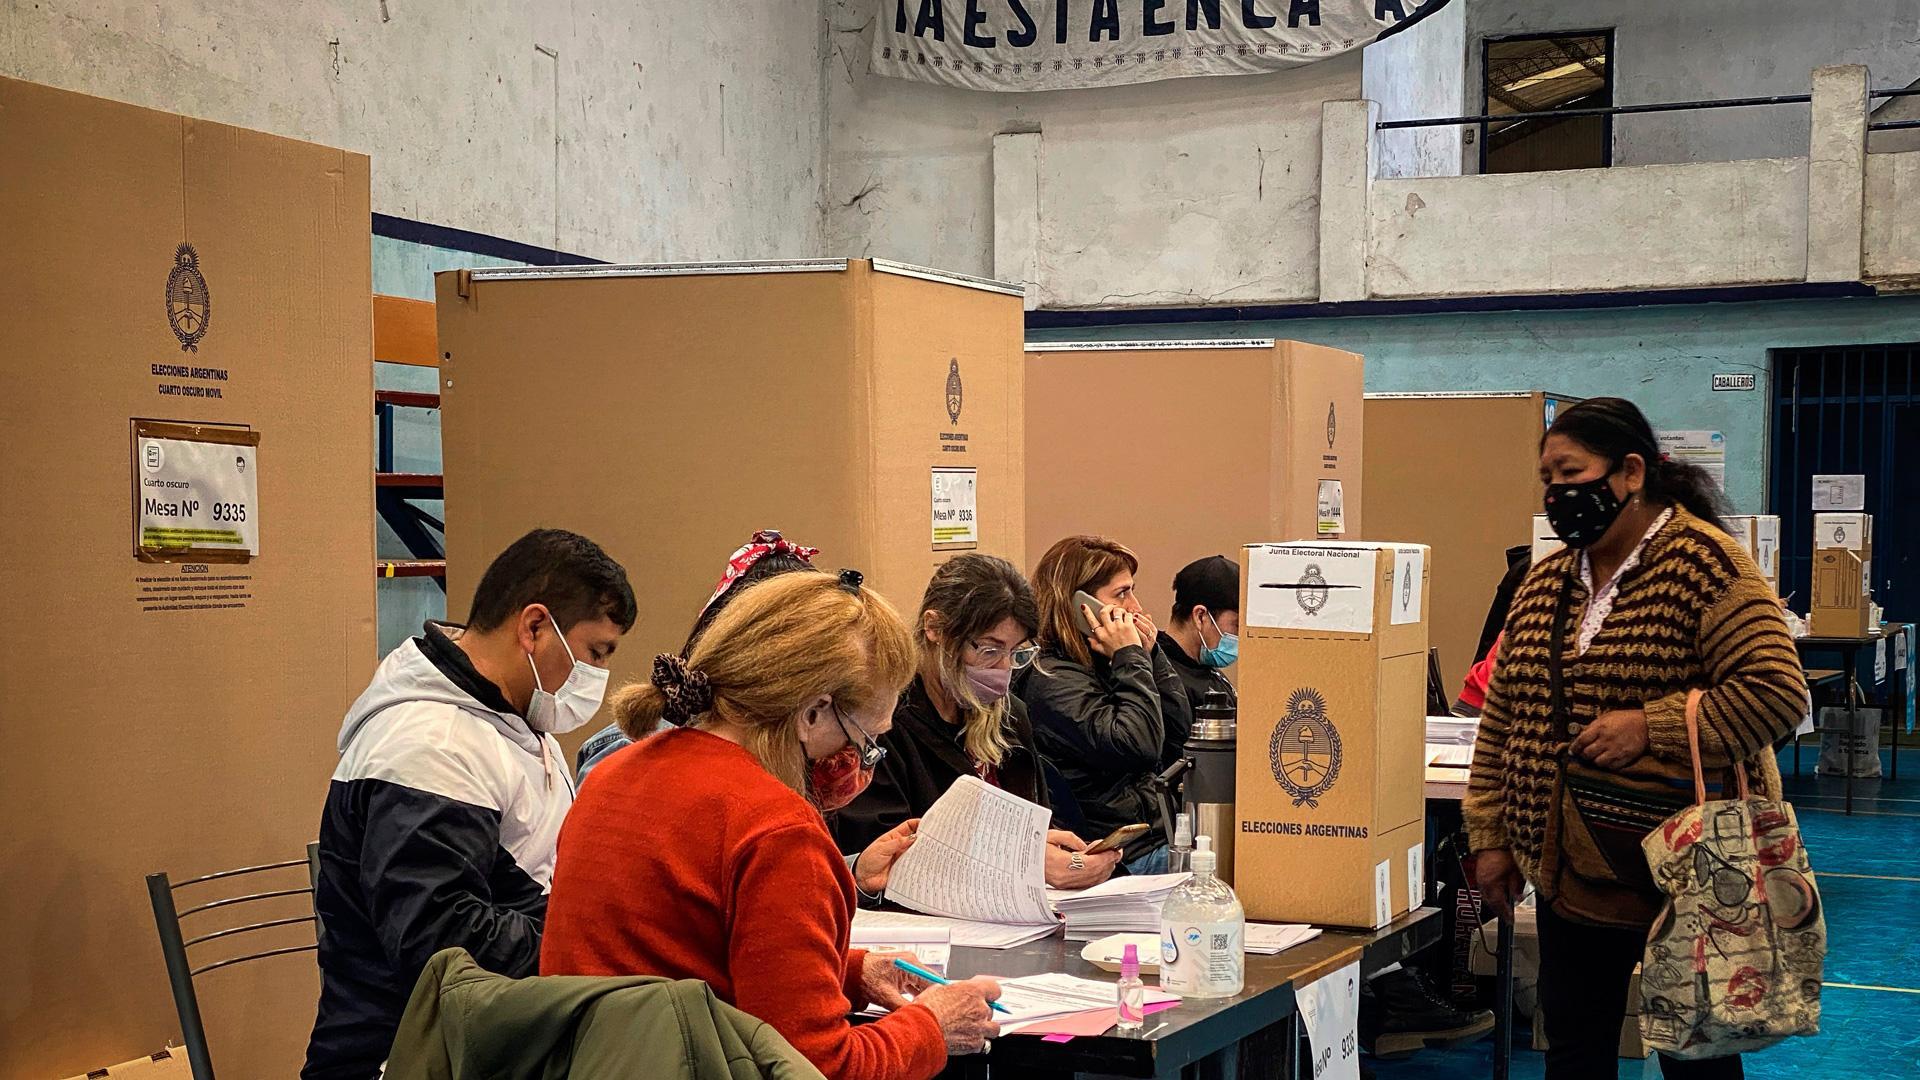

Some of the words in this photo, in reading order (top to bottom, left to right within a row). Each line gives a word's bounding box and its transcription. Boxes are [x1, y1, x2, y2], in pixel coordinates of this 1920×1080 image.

[152, 364, 190, 378] ELECCIONES
[190, 368, 228, 380] ARGENTINAS
[1714, 376, 1753, 388] CABALLEROS
[158, 383, 181, 395] CUARTO
[182, 386, 204, 397] OSCURO
[143, 478, 164, 488] Cuarto
[166, 480, 190, 489] oscuro
[145, 498, 178, 517] Mesa
[212, 502, 246, 522] 9335
[933, 509, 947, 521] Mesa
[958, 509, 973, 521] 9336
[1292, 548, 1325, 557] Electoral
[1327, 550, 1360, 558] Nacional
[1241, 820, 1302, 836] ELECCIONES
[1304, 824, 1368, 839] ARGENTINAS
